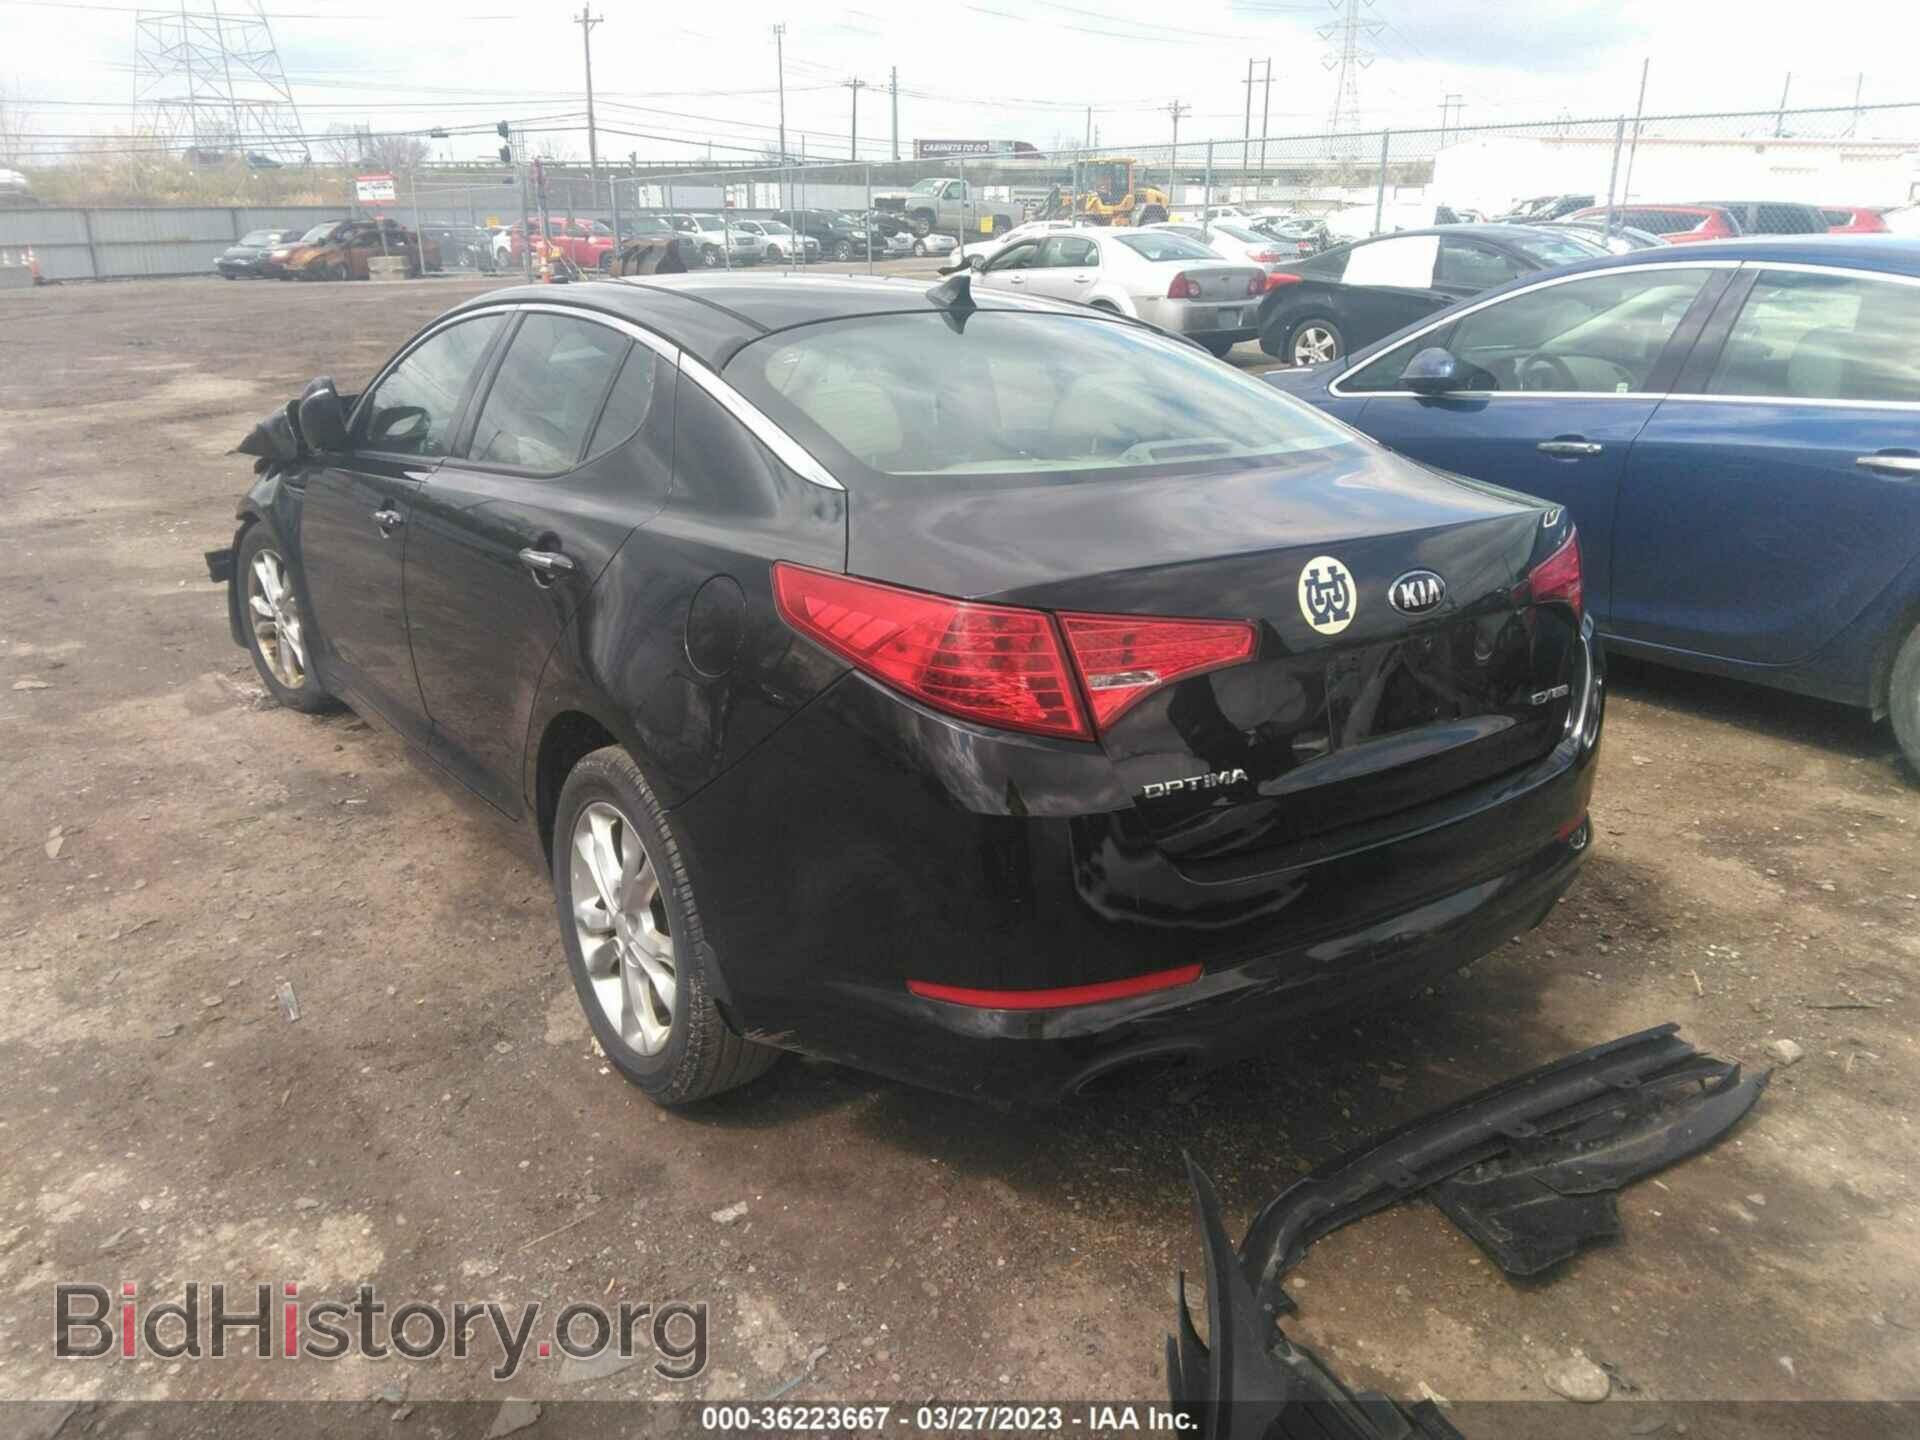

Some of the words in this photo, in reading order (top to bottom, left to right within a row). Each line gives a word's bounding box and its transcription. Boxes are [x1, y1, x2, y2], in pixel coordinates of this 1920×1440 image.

[963, 143, 973, 152] TO
[974, 143, 988, 153] GO
[1401, 579, 1441, 608] KIA
[1142, 768, 1248, 799] OPTIMA
